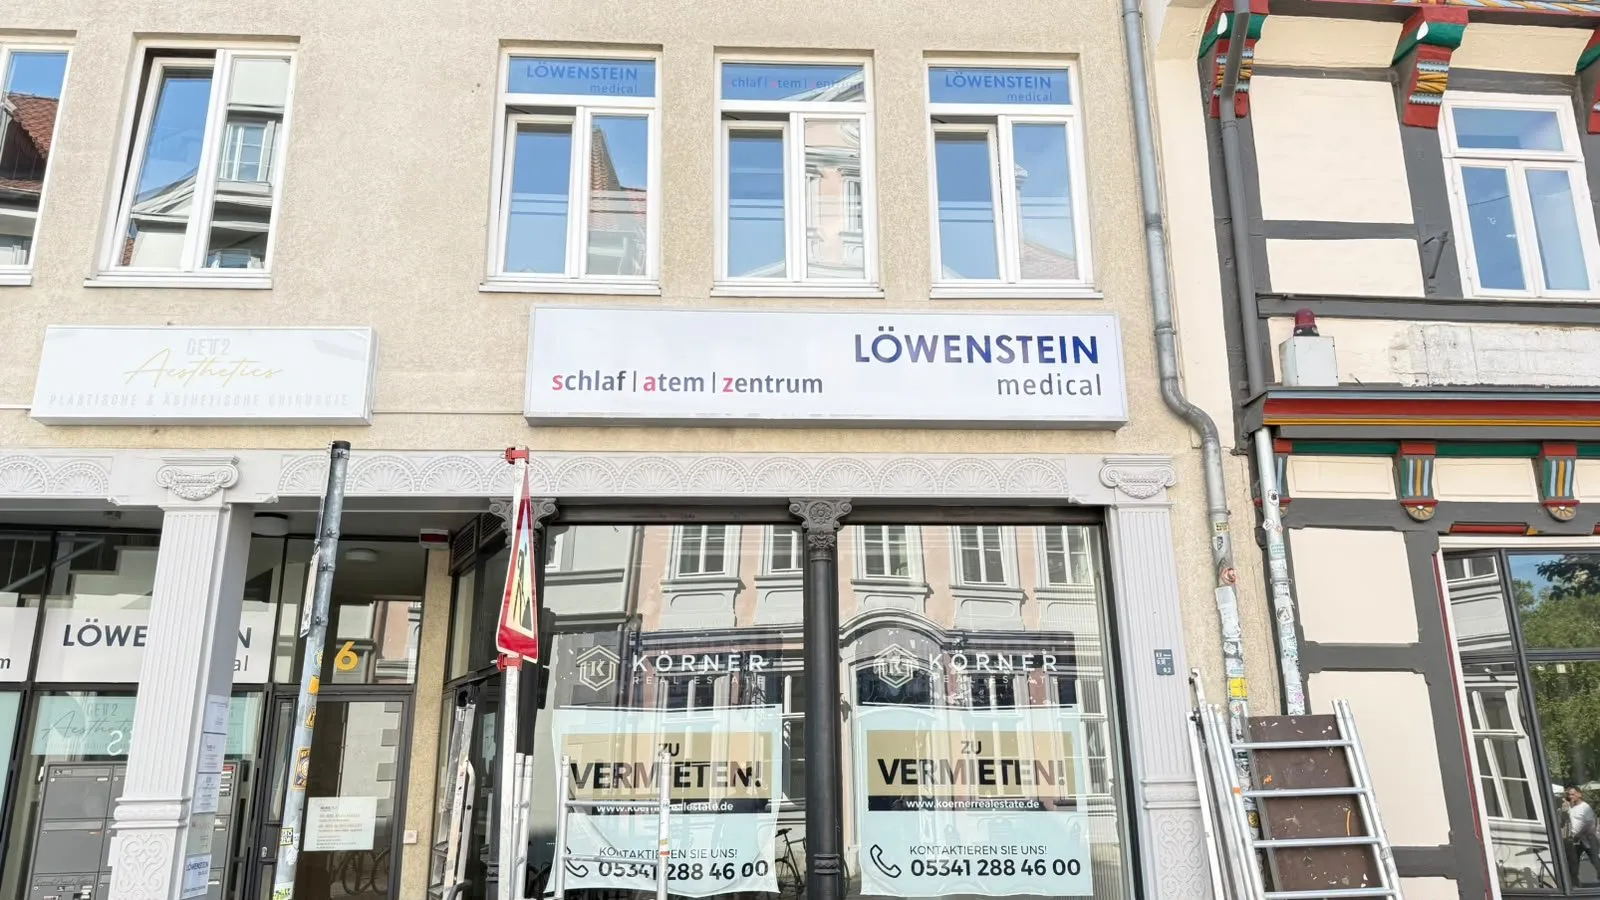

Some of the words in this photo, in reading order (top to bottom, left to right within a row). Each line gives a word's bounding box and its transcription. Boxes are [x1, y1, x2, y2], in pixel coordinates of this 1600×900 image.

[526, 61, 638, 80] LÖWENSTEIN
[945, 71, 1052, 89] LÖWENSTEIN
[589, 83, 638, 94] medical
[1007, 91, 1053, 103] medical
[854, 325, 1099, 364] LÖWENSTEIN
[123, 346, 285, 388] Aesthetics
[551, 369, 627, 391] schlaf
[643, 373, 704, 392] atem
[722, 374, 823, 393] zentrum
[997, 372, 1102, 396] medical
[334, 640, 359, 671] 6
[632, 650, 764, 672] KÖRNER
[929, 649, 1058, 672] KÖRNER
[960, 741, 982, 755] ZU
[570, 760, 762, 788] VERMETEN!
[877, 758, 1066, 786] VERMIETEN!
[906, 798, 1040, 810] www.koernerrealestate.de
[599, 846, 686, 859] KONTAKTIEEN
[690, 848, 707, 859] SIE
[710, 847, 738, 859] UNS!
[909, 844, 996, 855] KONTAKTIEREN
[1000, 844, 1018, 855] SIE
[1021, 844, 1048, 855] UNS!
[598, 860, 657, 881] 05341
[667, 862, 704, 881] 288
[709, 861, 735, 881] 46
[741, 859, 769, 878] 00
[910, 858, 971, 877] 05341
[977, 858, 1016, 876] 288
[1020, 858, 1047, 876] 46
[1052, 858, 1082, 876] 00
